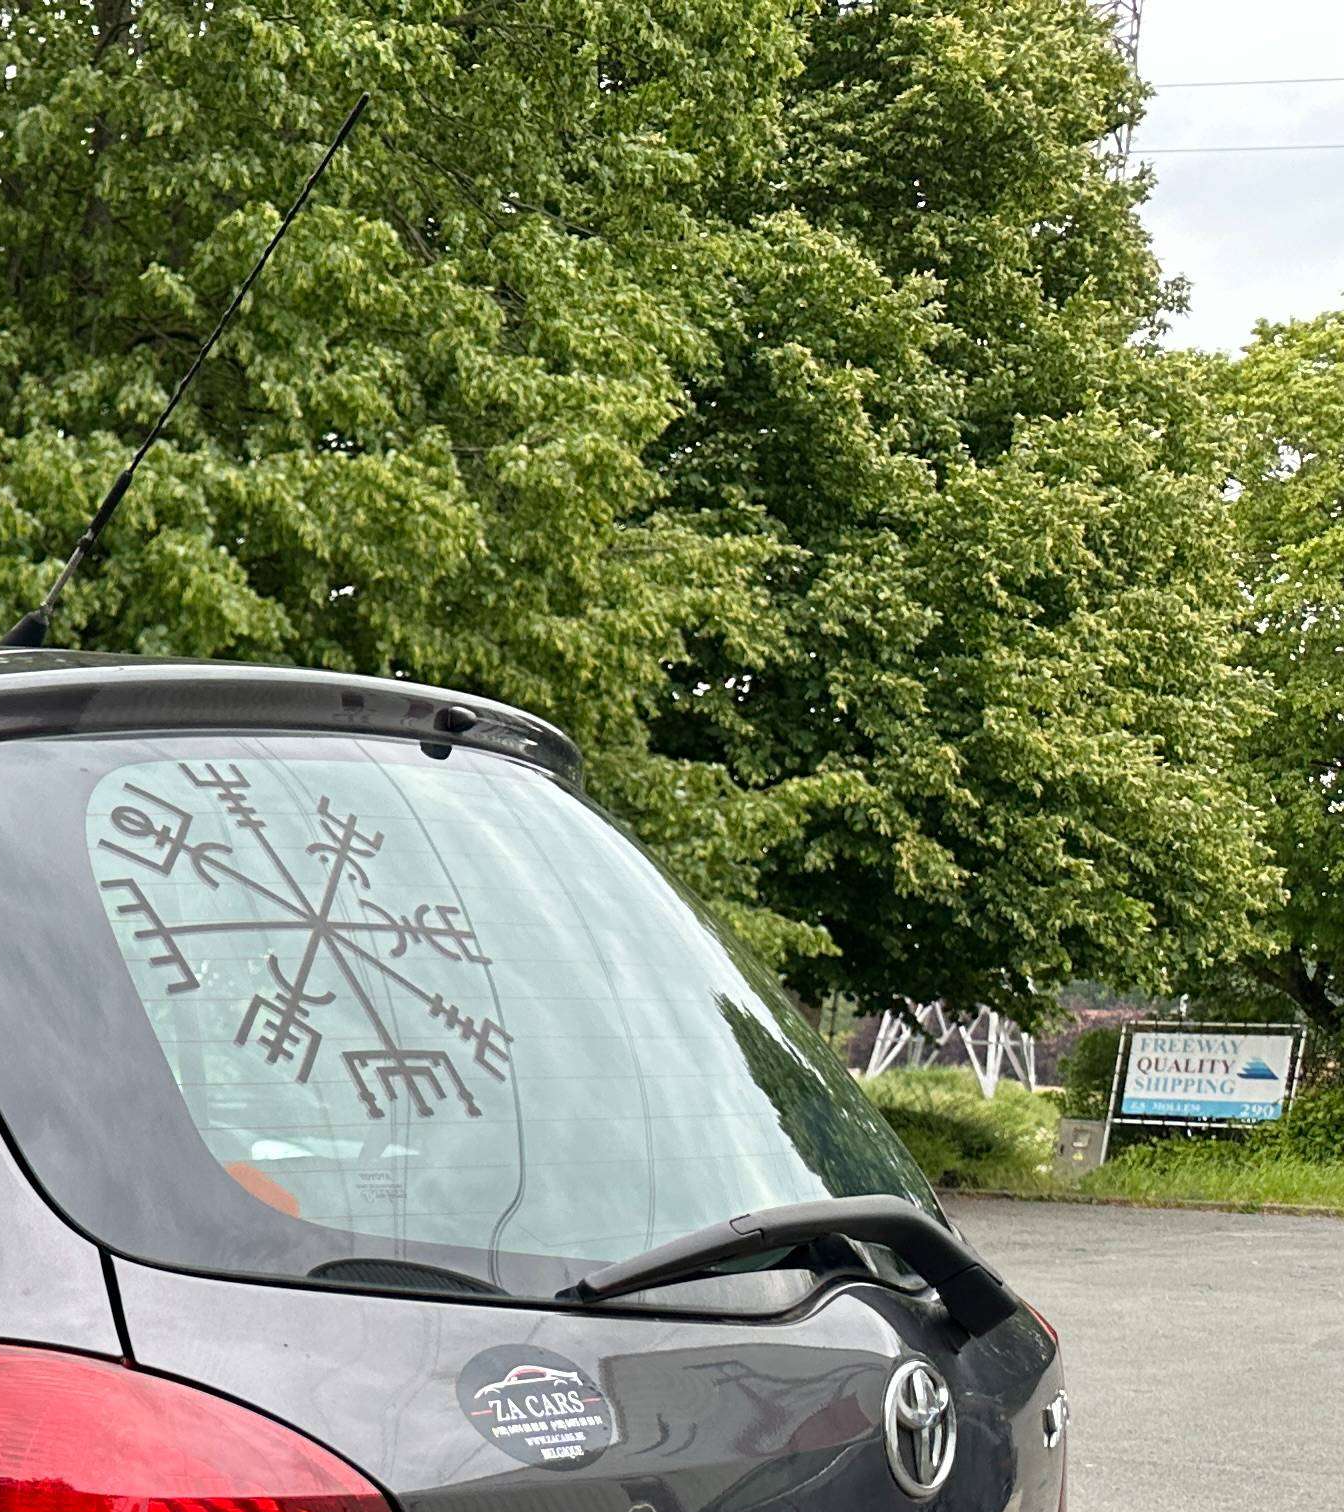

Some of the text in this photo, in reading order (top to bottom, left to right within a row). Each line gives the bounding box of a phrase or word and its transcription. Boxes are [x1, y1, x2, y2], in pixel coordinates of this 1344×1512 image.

[1141, 1038, 1242, 1055] FREEWAY
[1137, 1058, 1236, 1075] QUALITY
[1134, 1078, 1235, 1094] SHIPPING
[1241, 1103, 1276, 1119] 290
[488, 1390, 585, 1422] ZA CARS
